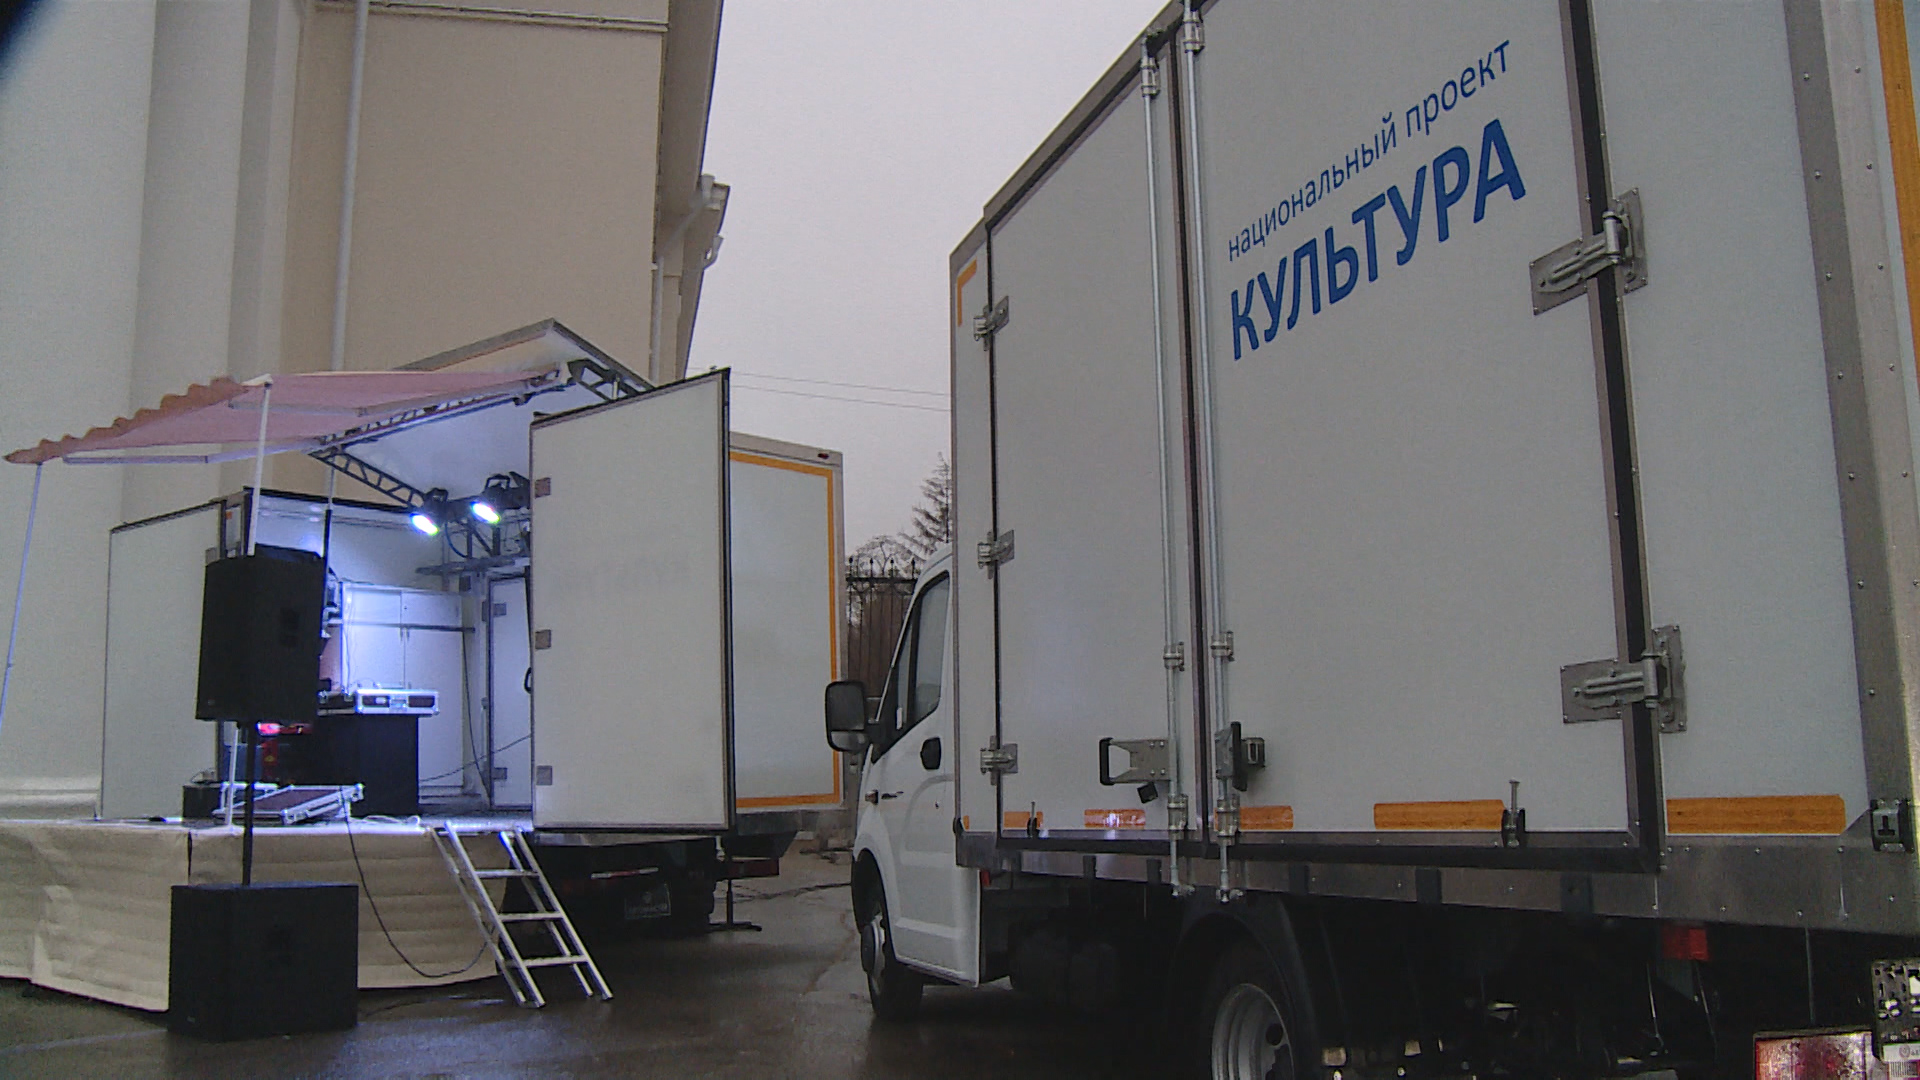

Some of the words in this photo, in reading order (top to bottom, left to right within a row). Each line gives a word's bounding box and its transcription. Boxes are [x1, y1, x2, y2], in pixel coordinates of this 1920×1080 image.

[1229, 112, 1397, 261] национальный
[1406, 40, 1510, 137] проект
[1231, 119, 1526, 360] КУЛЬТУРА
